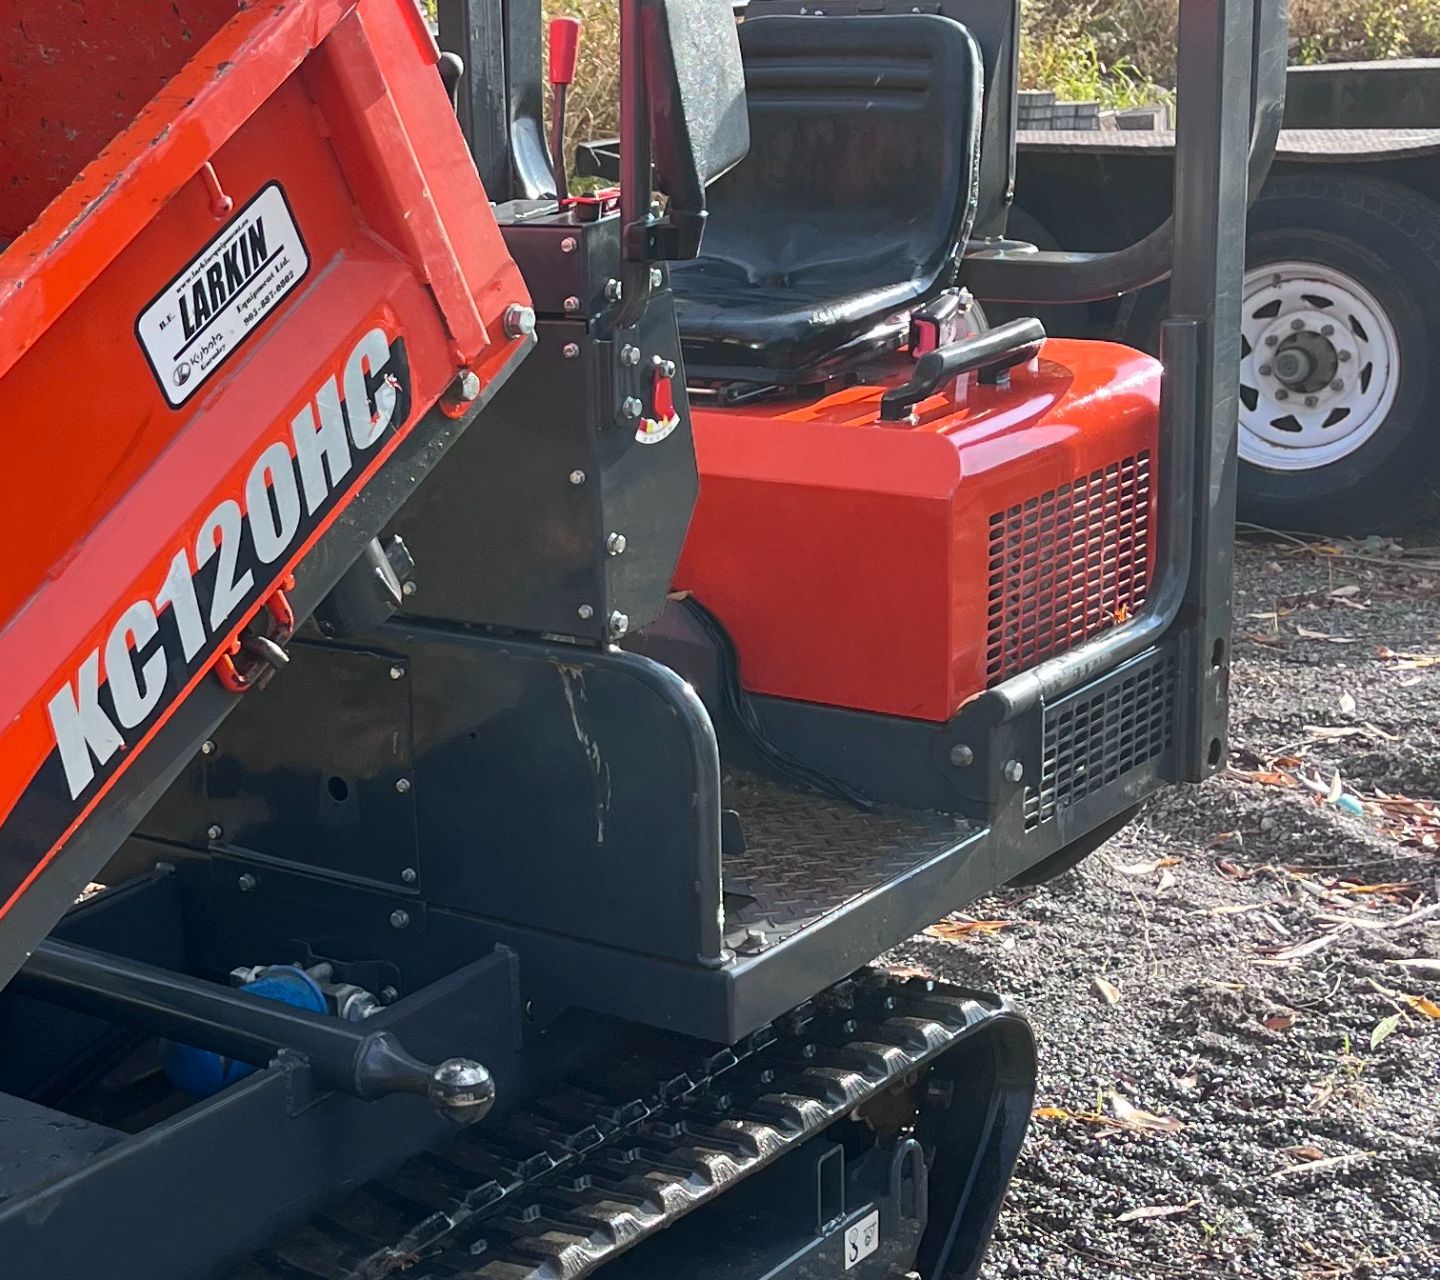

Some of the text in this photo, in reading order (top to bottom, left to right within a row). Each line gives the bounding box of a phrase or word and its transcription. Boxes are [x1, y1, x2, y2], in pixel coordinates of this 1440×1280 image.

[178, 215, 268, 341] LARKIN
[236, 272, 275, 314] Equipment
[189, 333, 224, 366] Kubota
[48, 328, 397, 801] KC120HC
